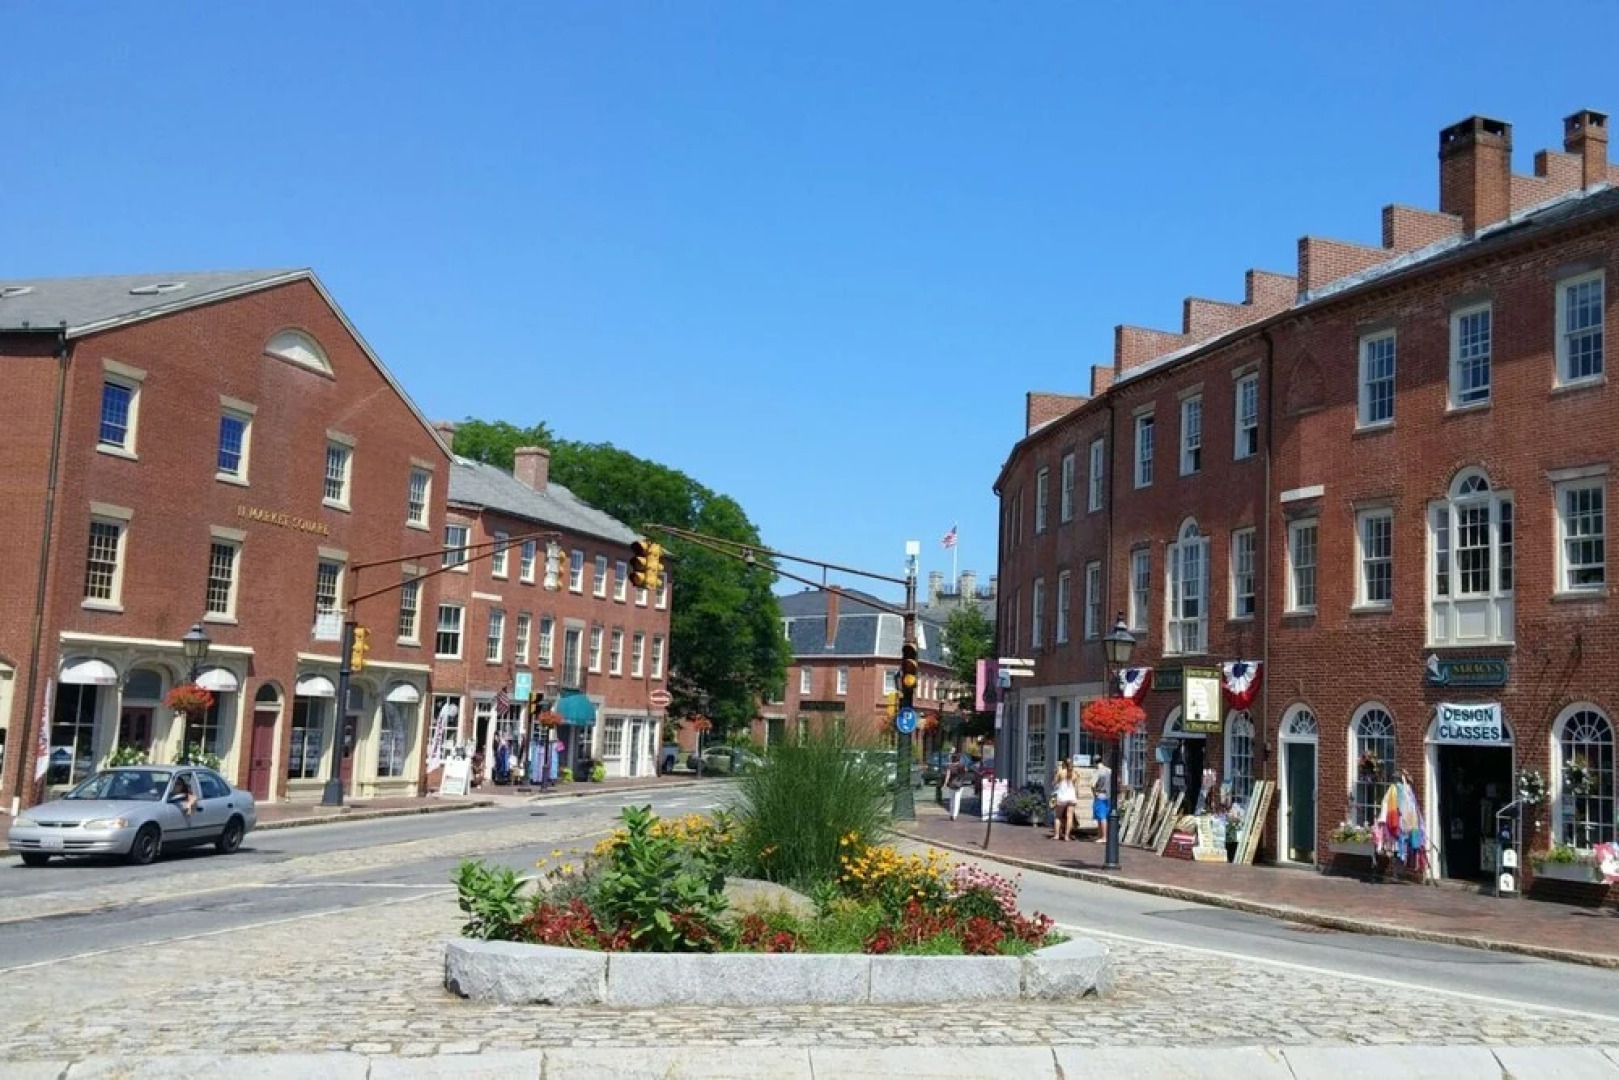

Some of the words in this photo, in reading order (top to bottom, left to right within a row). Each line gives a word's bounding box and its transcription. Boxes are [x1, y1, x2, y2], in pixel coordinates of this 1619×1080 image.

[248, 506, 290, 525] MARKET
[292, 517, 330, 535] SQUARE
[1443, 707, 1494, 722] DESIGN
[1440, 724, 1500, 740] CLASSES
